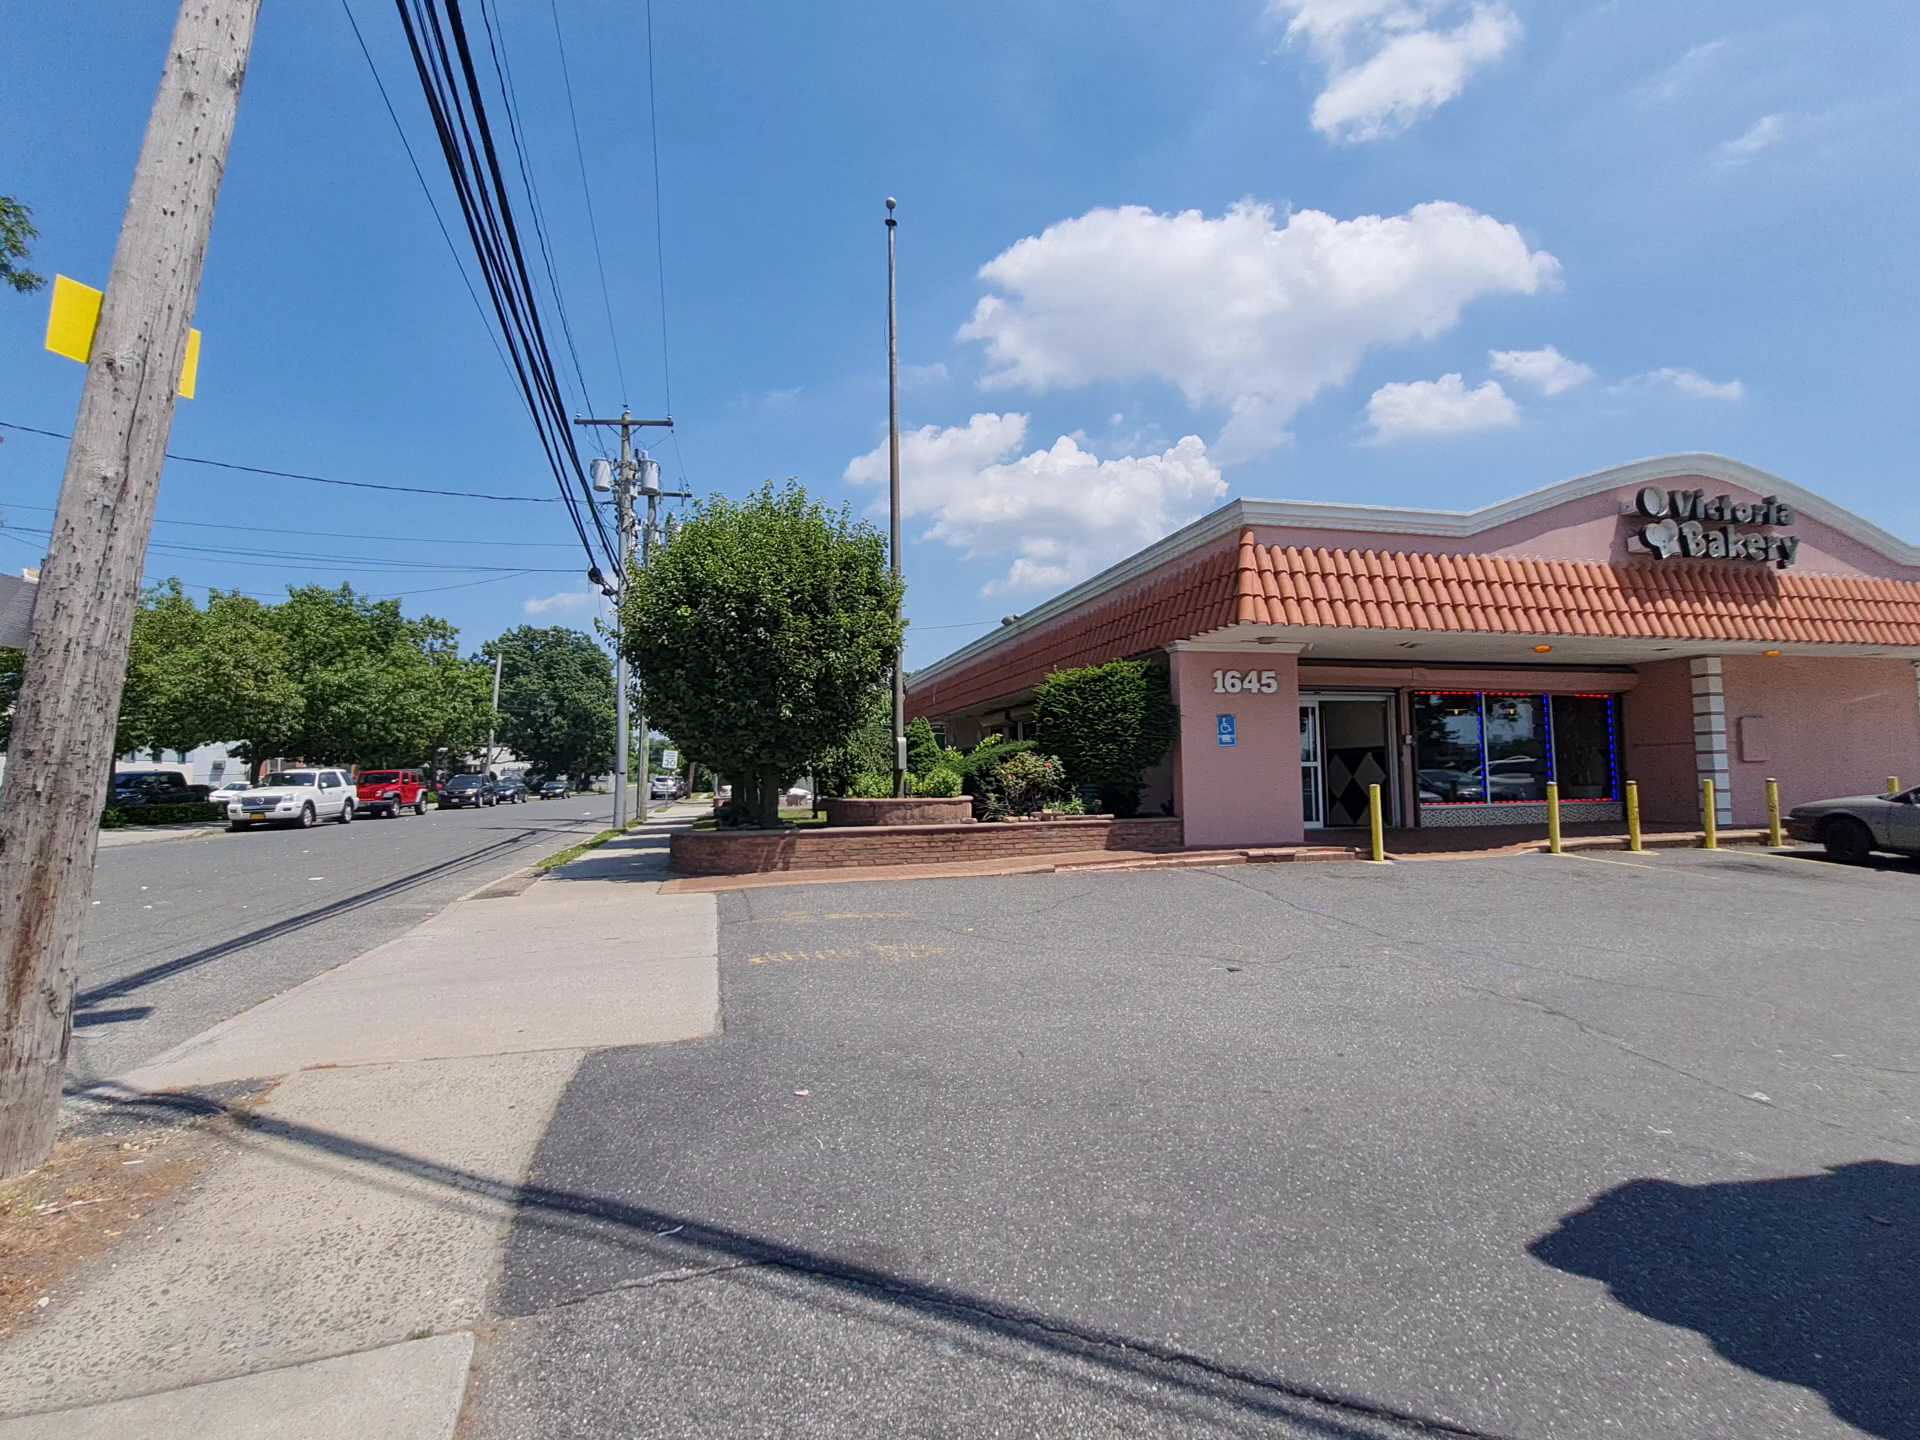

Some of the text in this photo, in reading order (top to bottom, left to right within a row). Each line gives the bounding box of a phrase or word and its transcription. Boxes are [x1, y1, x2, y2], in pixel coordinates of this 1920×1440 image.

[1671, 489, 1794, 525] Victoria
[1680, 521, 1799, 569] Bakery
[1213, 670, 1278, 693] 1645
[664, 759, 676, 767] 30
